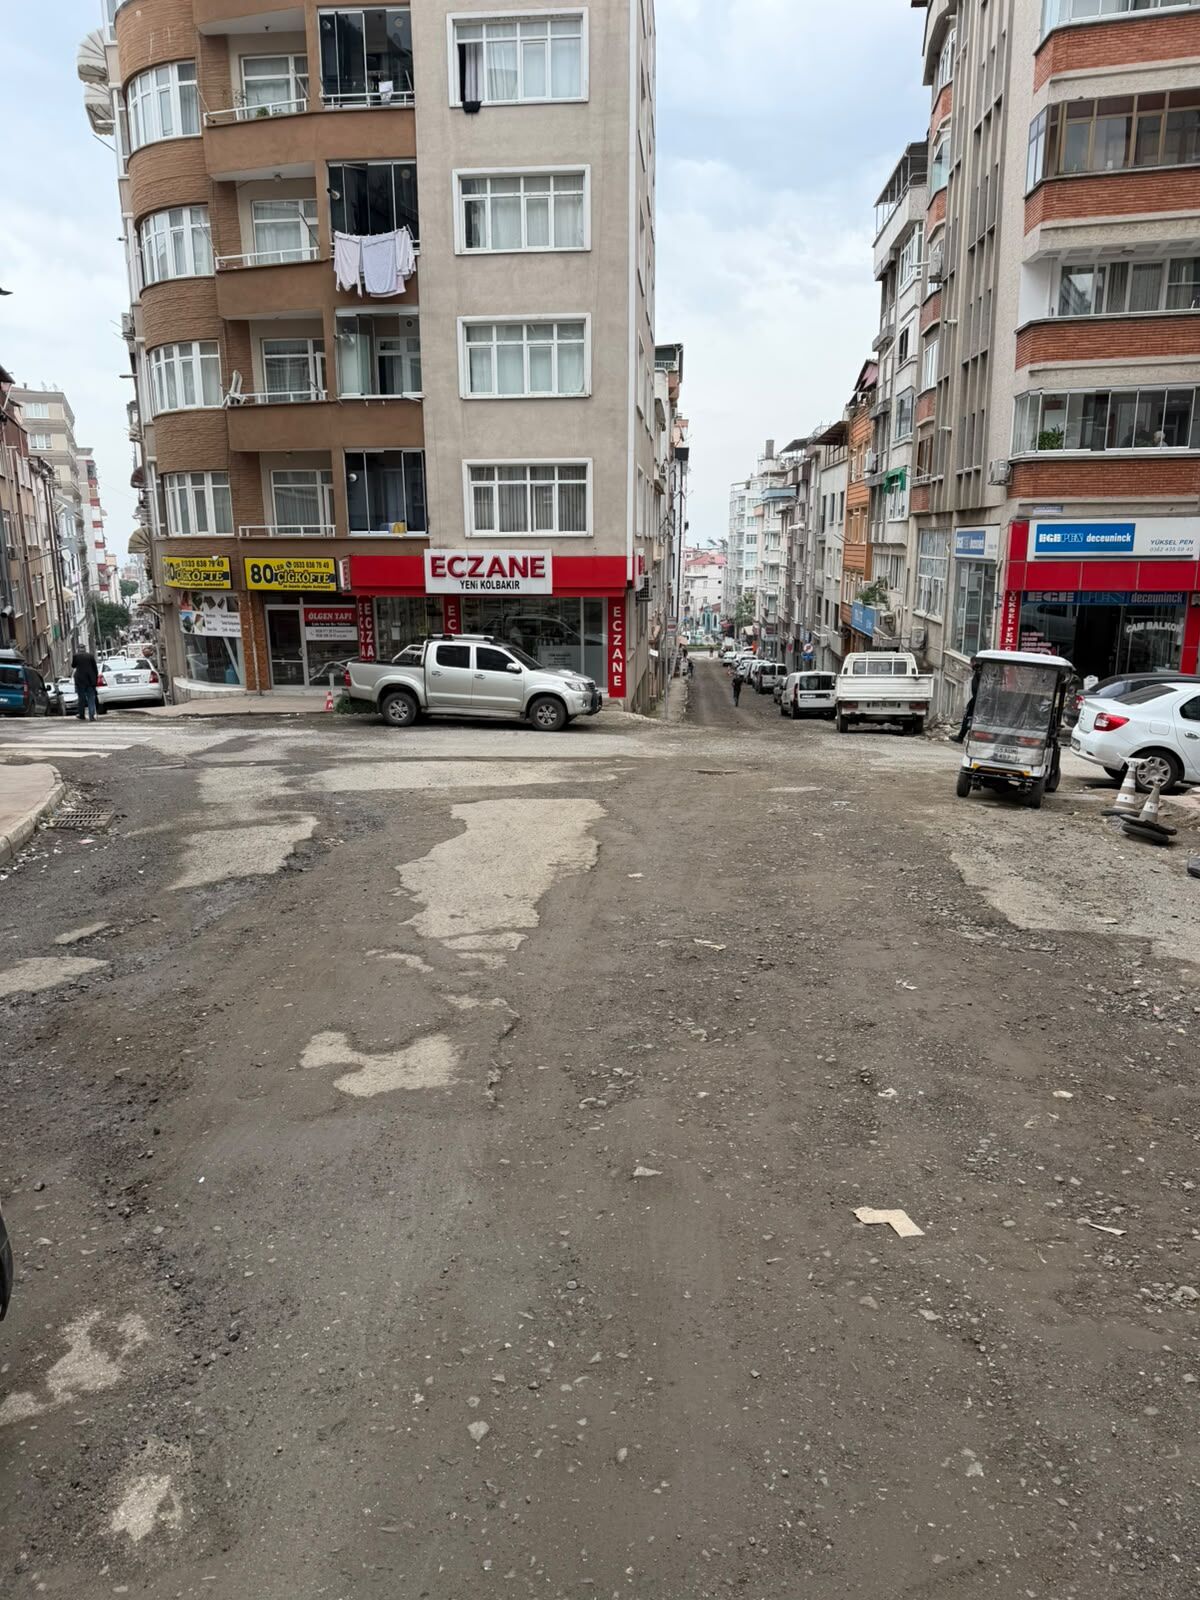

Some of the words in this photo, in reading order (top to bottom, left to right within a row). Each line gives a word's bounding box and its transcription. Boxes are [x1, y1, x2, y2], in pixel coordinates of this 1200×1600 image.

[1086, 532, 1132, 543] deceuninck
[1150, 538, 1177, 546] YÜKSEL
[430, 555, 546, 578] ECZANE
[251, 563, 274, 584] 80
[480, 580, 520, 590] KOLBAKIR
[1131, 591, 1183, 603] deceuninck
[612, 606, 623, 686] ECZANE
